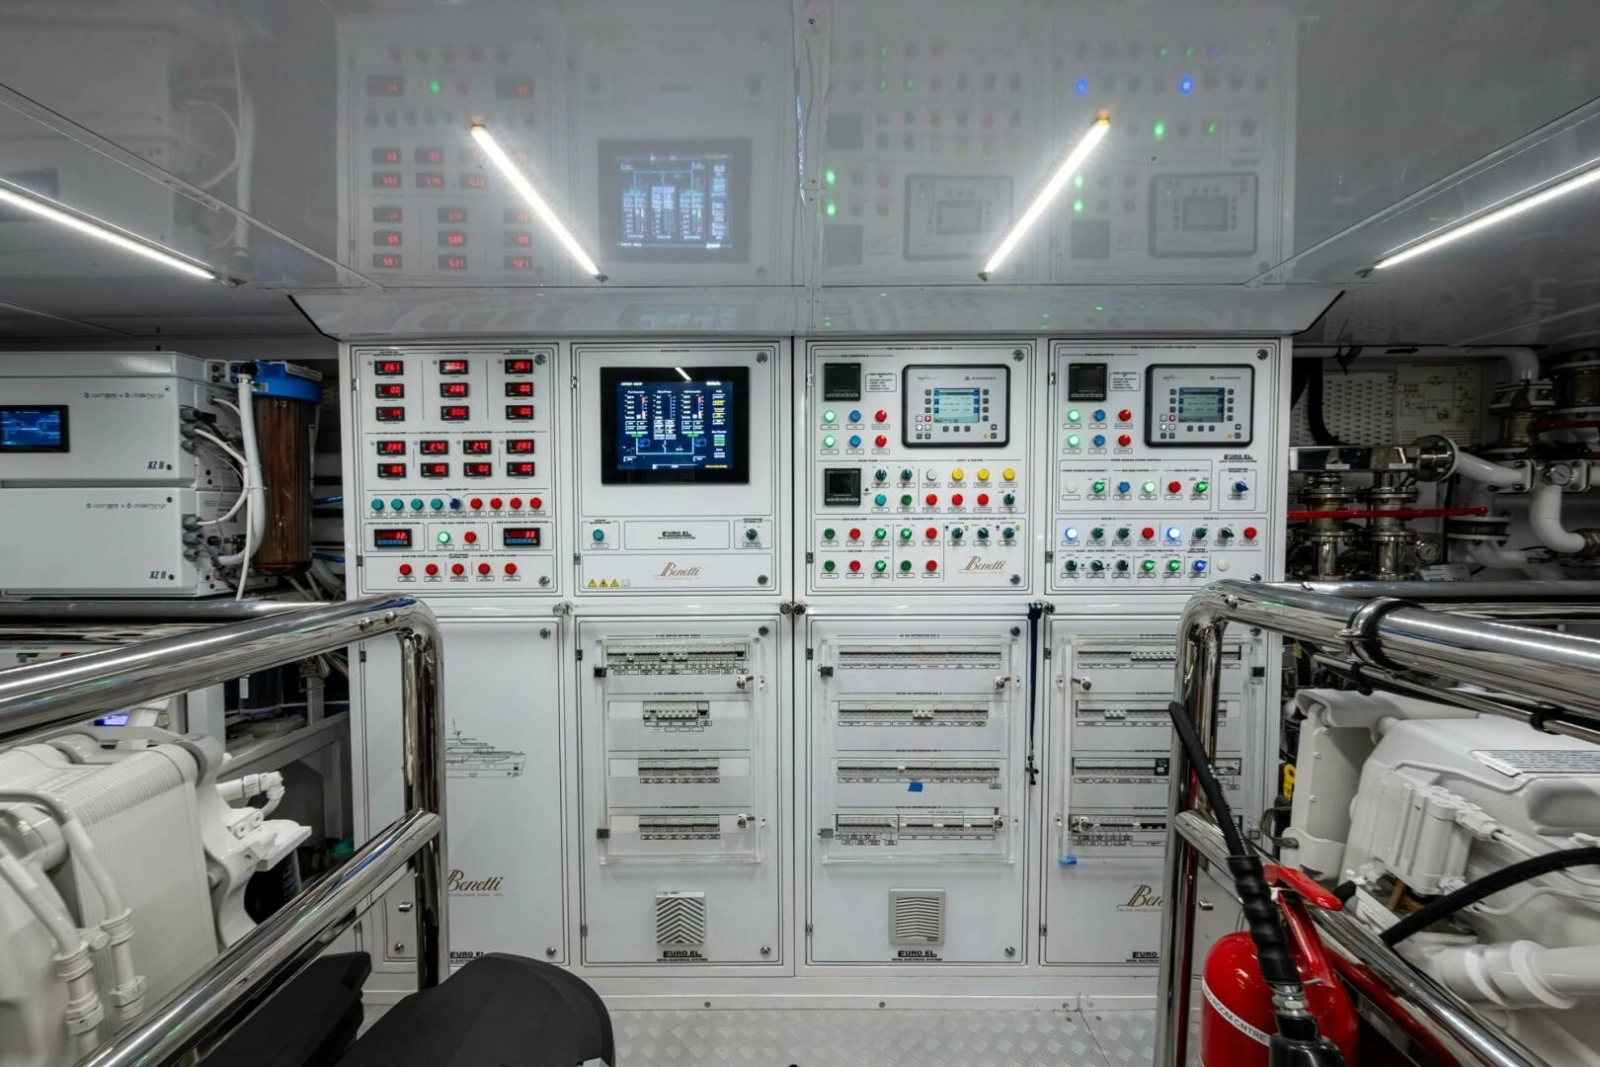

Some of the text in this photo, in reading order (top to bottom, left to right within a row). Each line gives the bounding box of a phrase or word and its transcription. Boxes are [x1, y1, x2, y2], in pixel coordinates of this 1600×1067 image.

[655, 562, 700, 577] Benetti
[958, 556, 1006, 572] Benetti
[448, 870, 504, 892] Benetti
[663, 950, 688, 958] EURO
[898, 950, 922, 958] EURO
